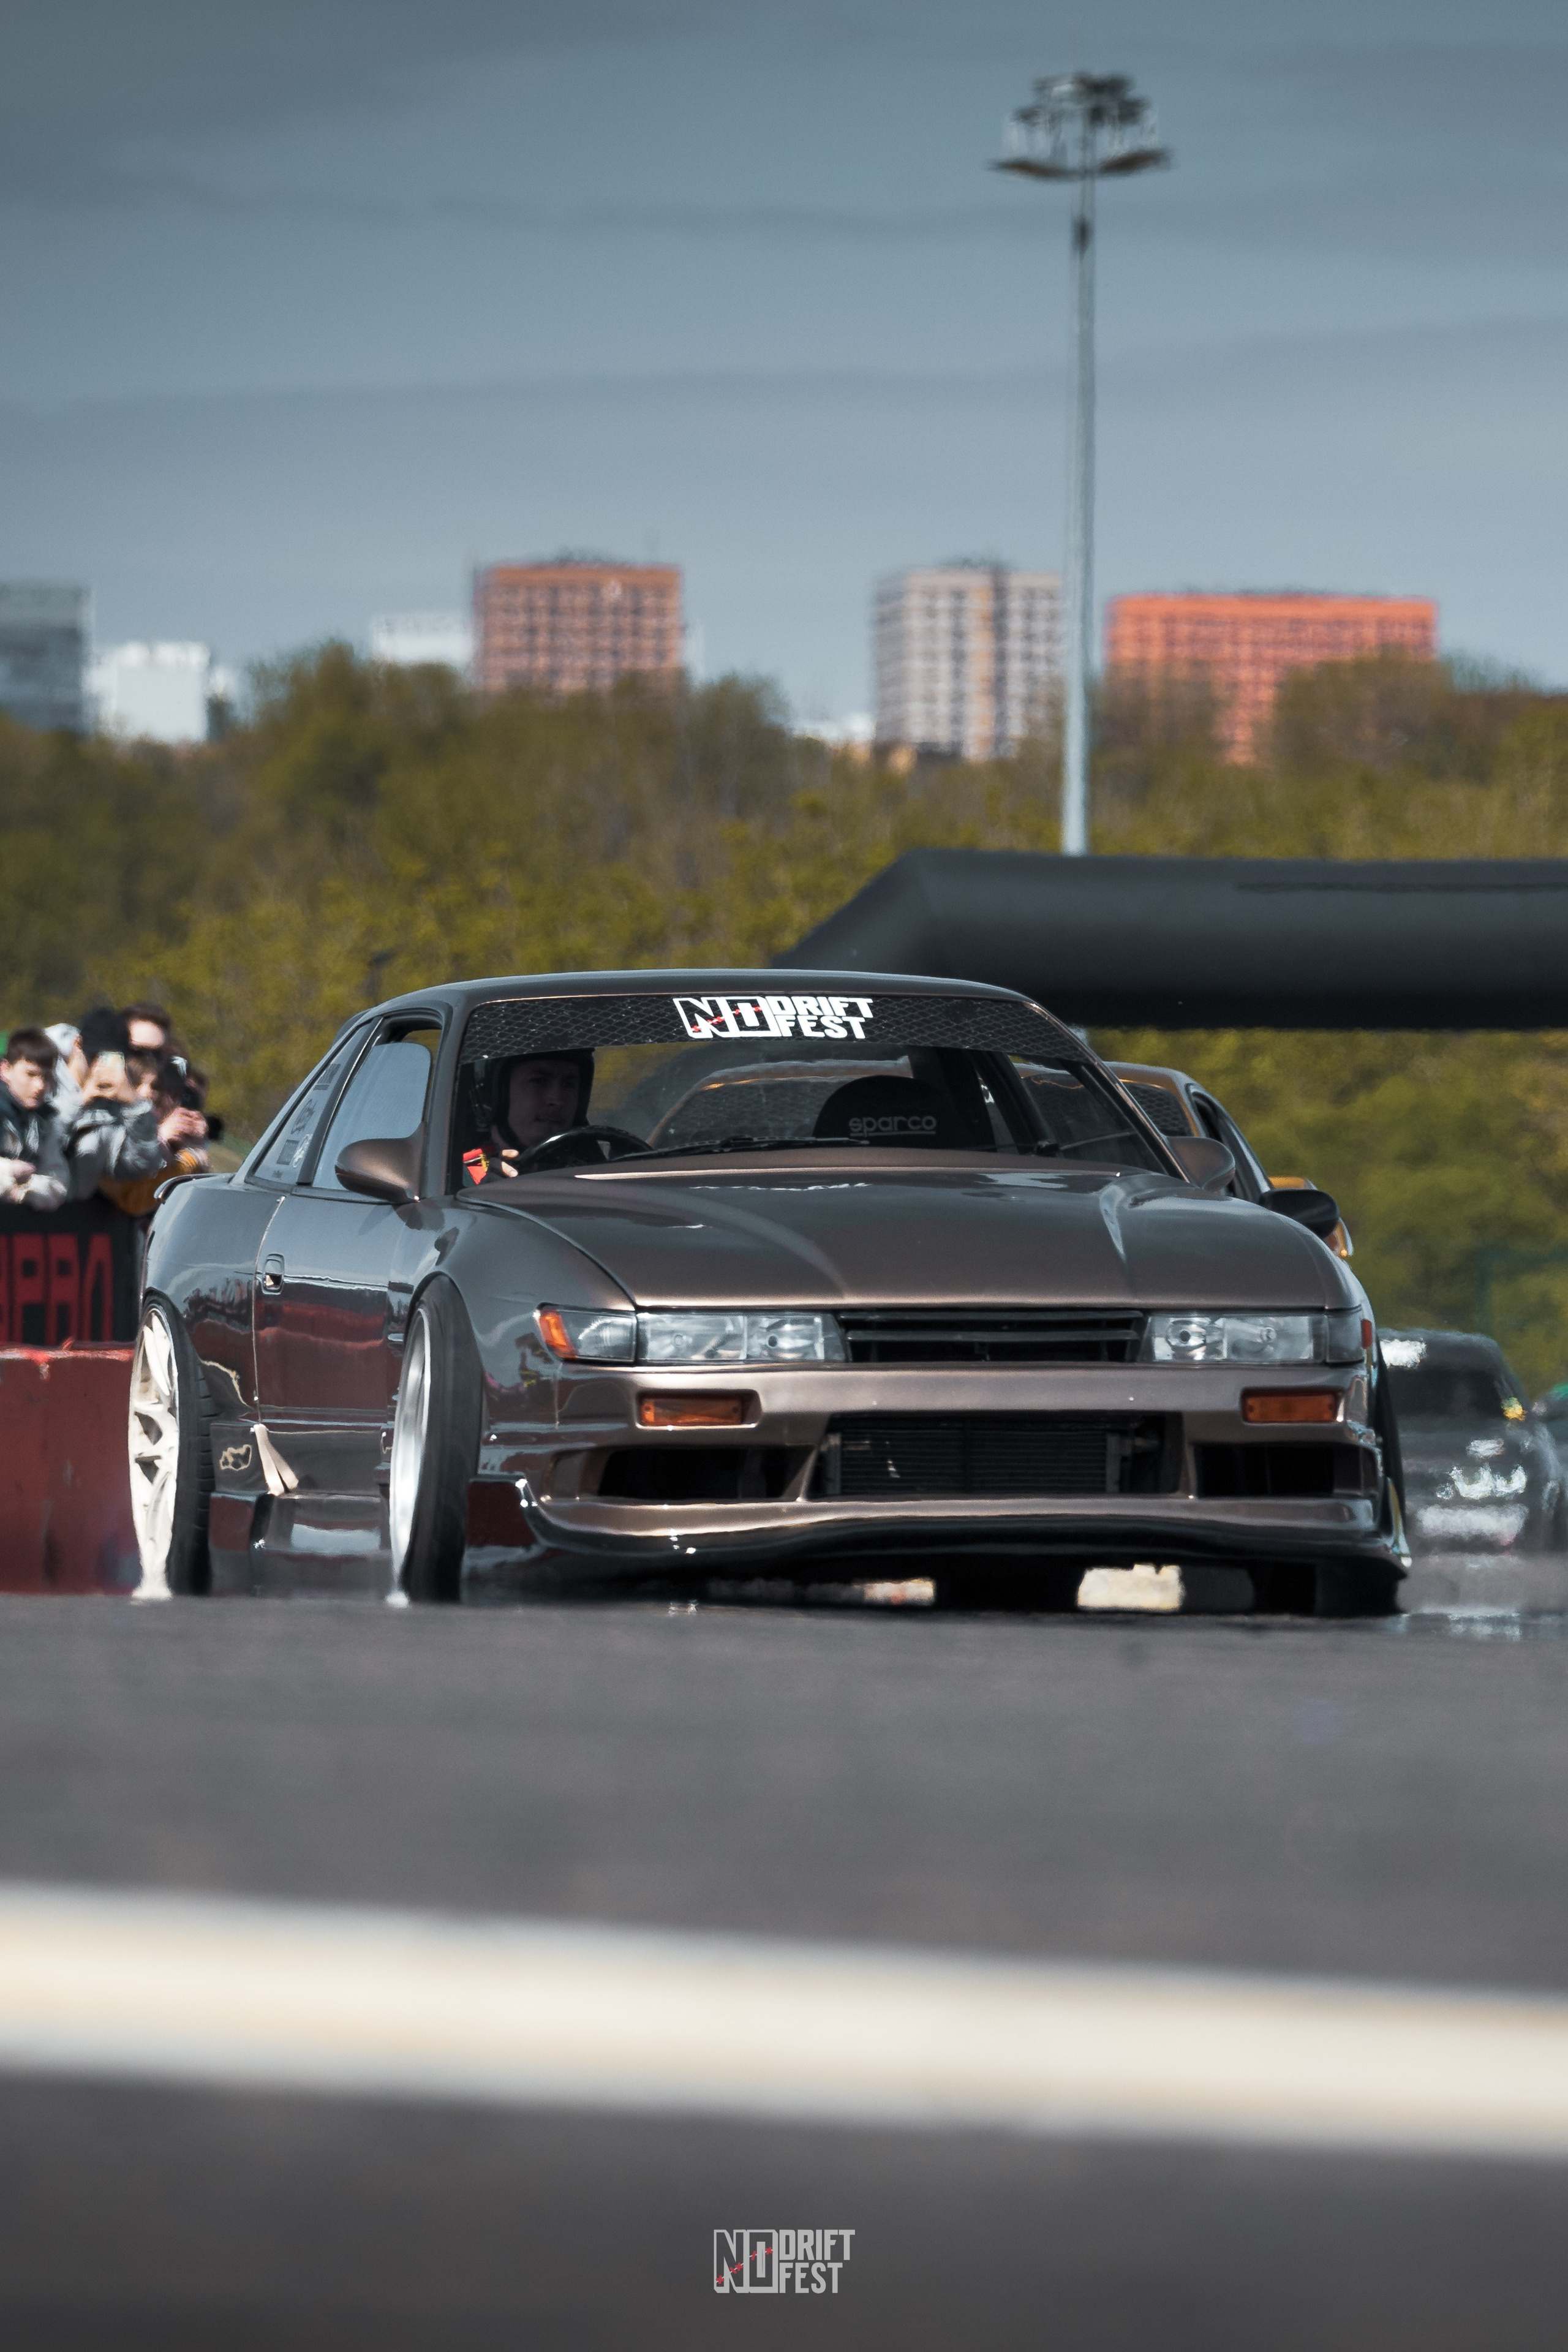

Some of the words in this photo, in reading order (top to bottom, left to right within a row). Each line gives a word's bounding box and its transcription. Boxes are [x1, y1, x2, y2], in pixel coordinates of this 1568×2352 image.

[765, 995, 874, 1019] DRIFT
[774, 1016, 866, 1039] FEST
[848, 1115, 937, 1137] sparco
